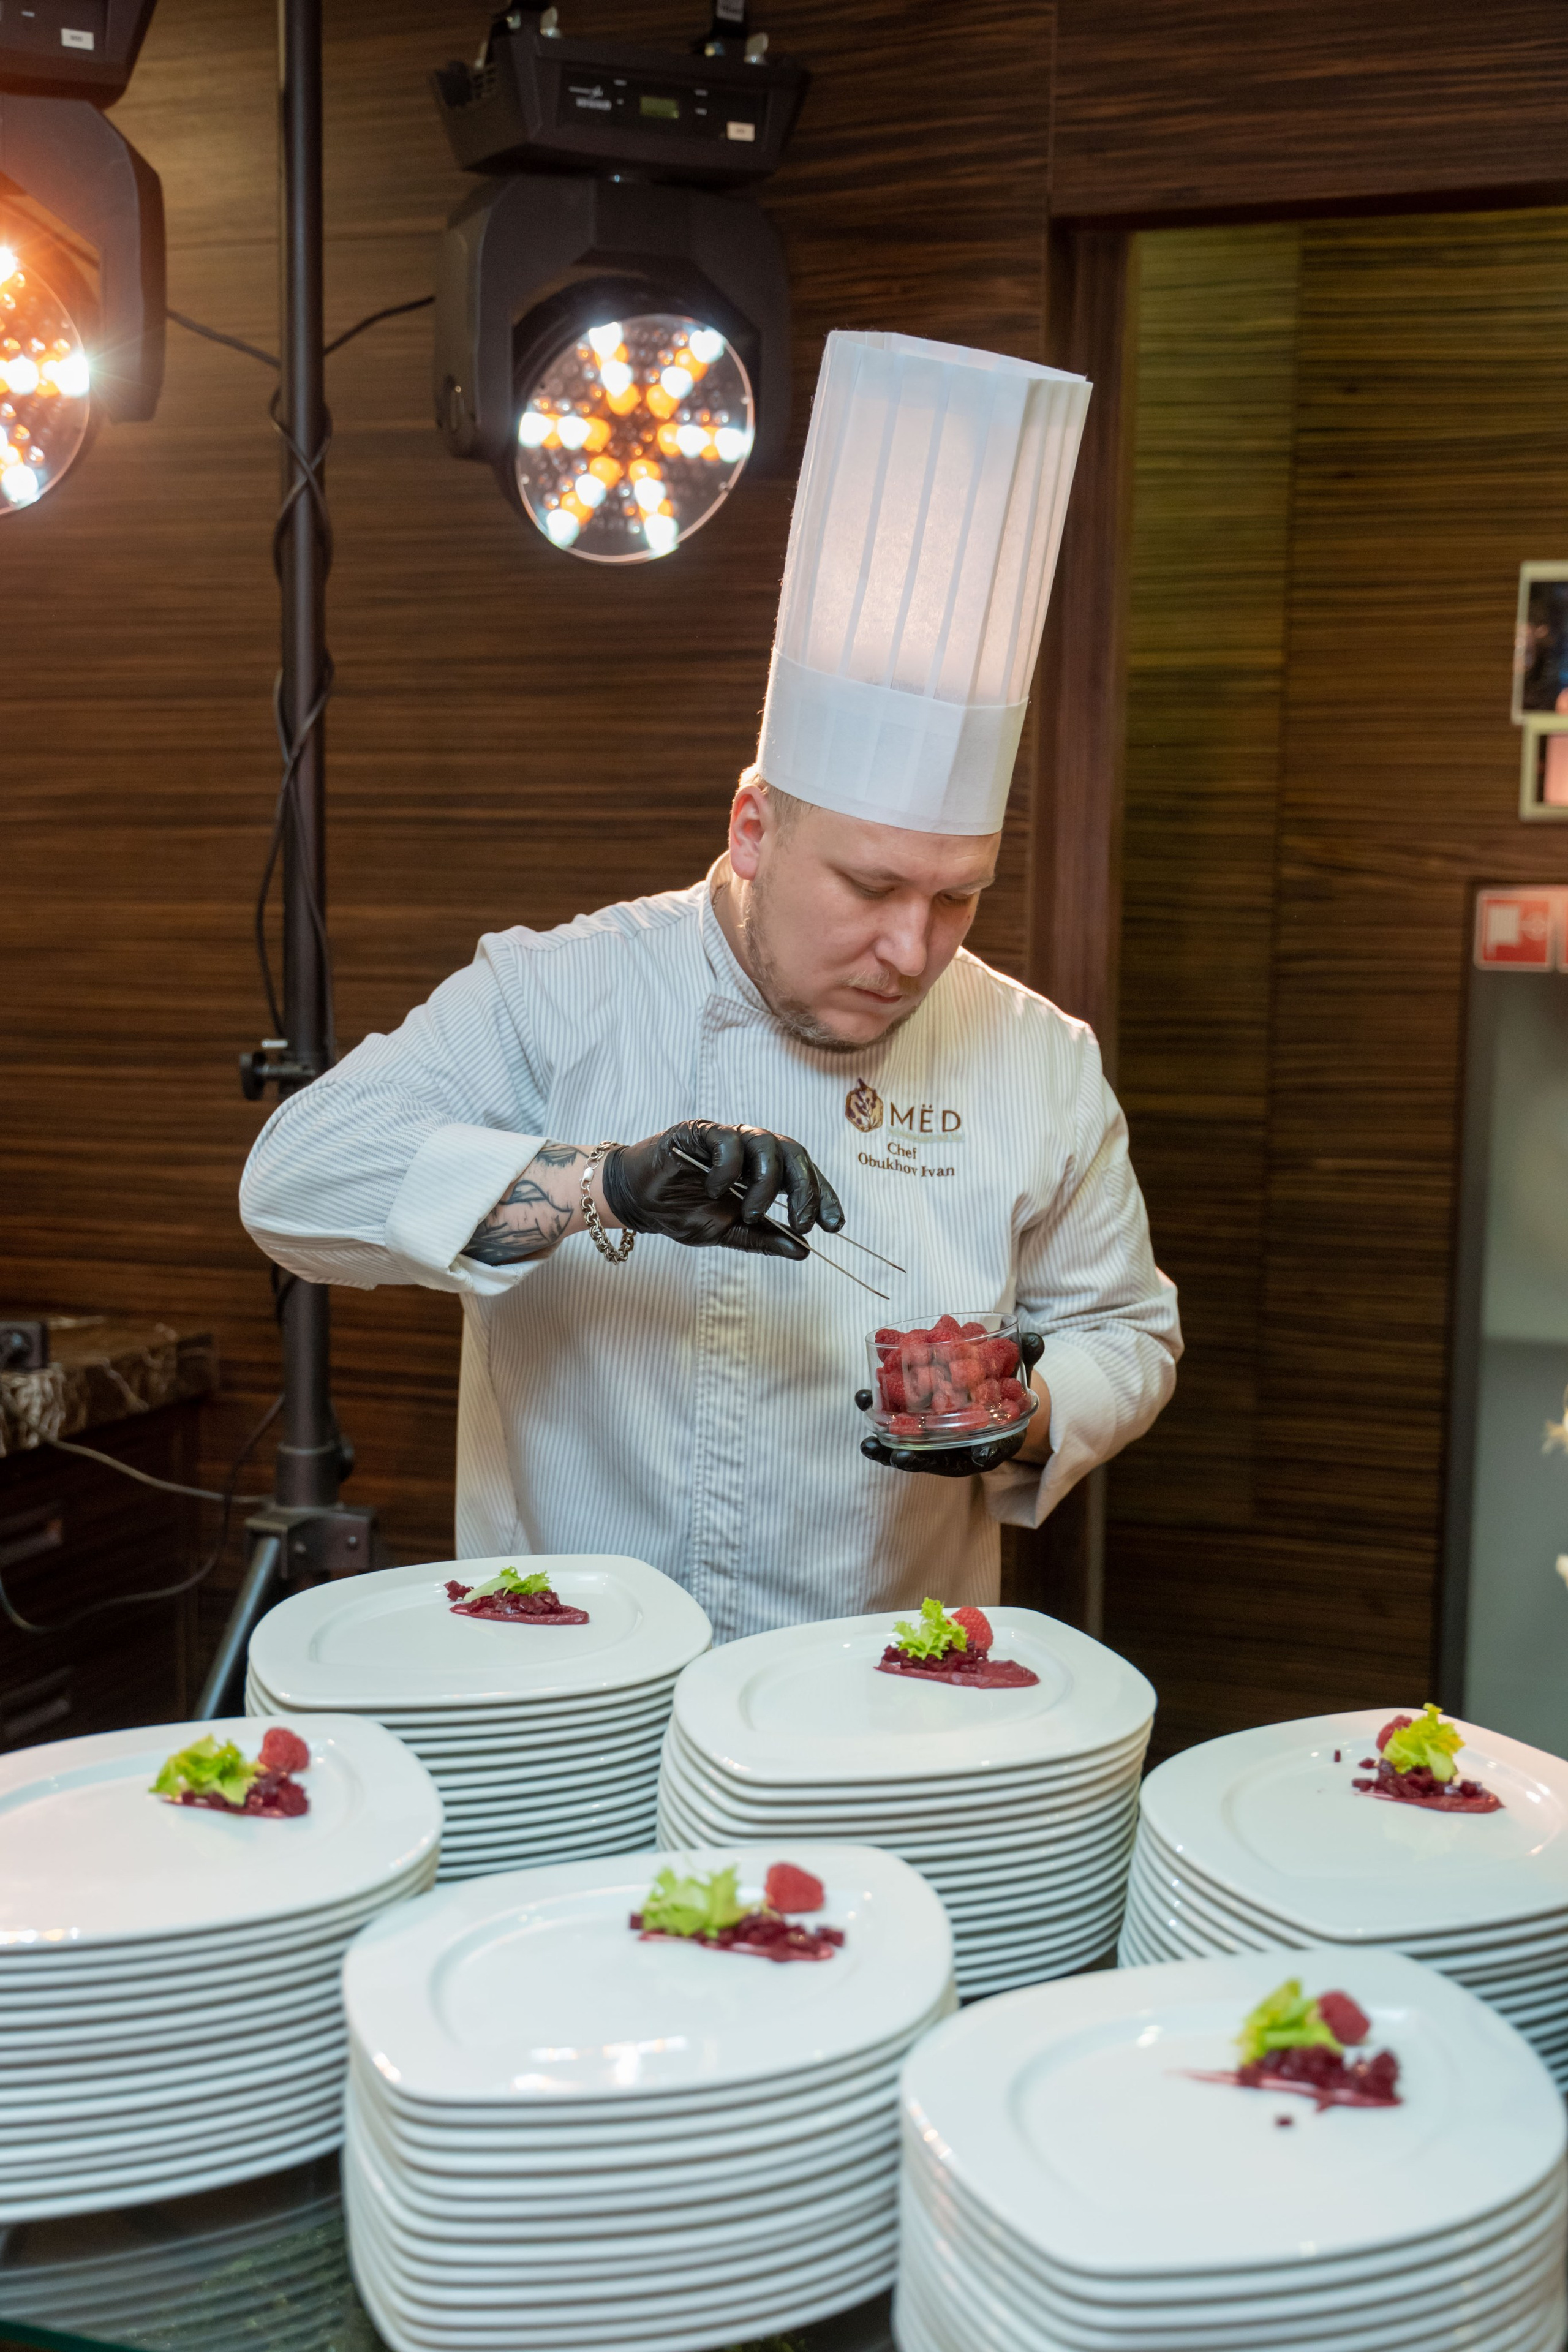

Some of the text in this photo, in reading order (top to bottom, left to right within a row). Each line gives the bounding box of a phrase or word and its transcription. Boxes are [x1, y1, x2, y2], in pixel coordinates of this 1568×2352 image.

[888, 1142, 917, 1159] Chef
[858, 1152, 955, 1177] Obukhov Ivan
